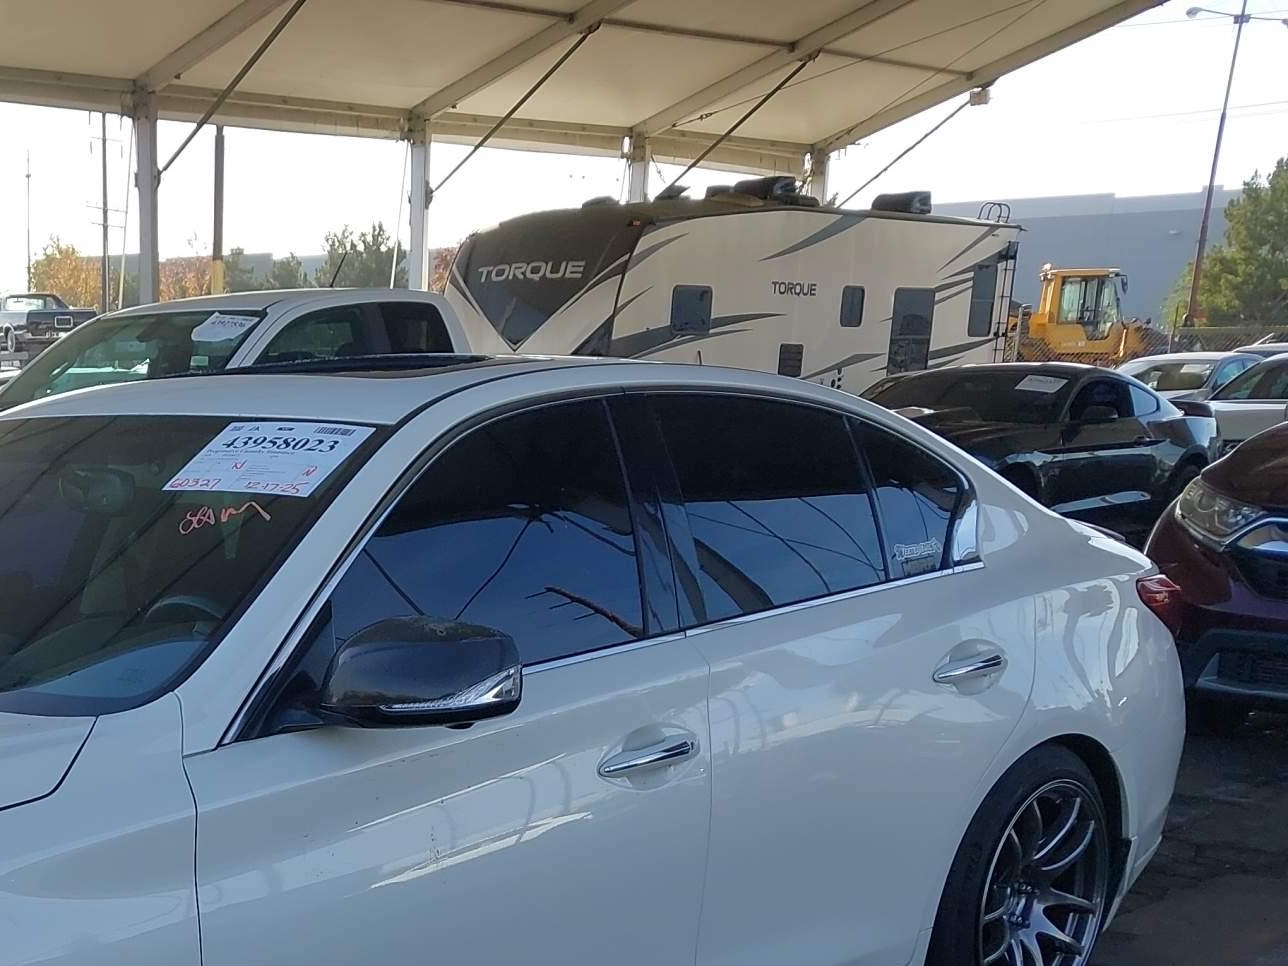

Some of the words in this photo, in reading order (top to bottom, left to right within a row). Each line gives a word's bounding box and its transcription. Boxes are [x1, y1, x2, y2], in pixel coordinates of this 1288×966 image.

[478, 261, 585, 283] TORQUE
[771, 281, 817, 297] TORQUE
[221, 435, 340, 453] 43958023
